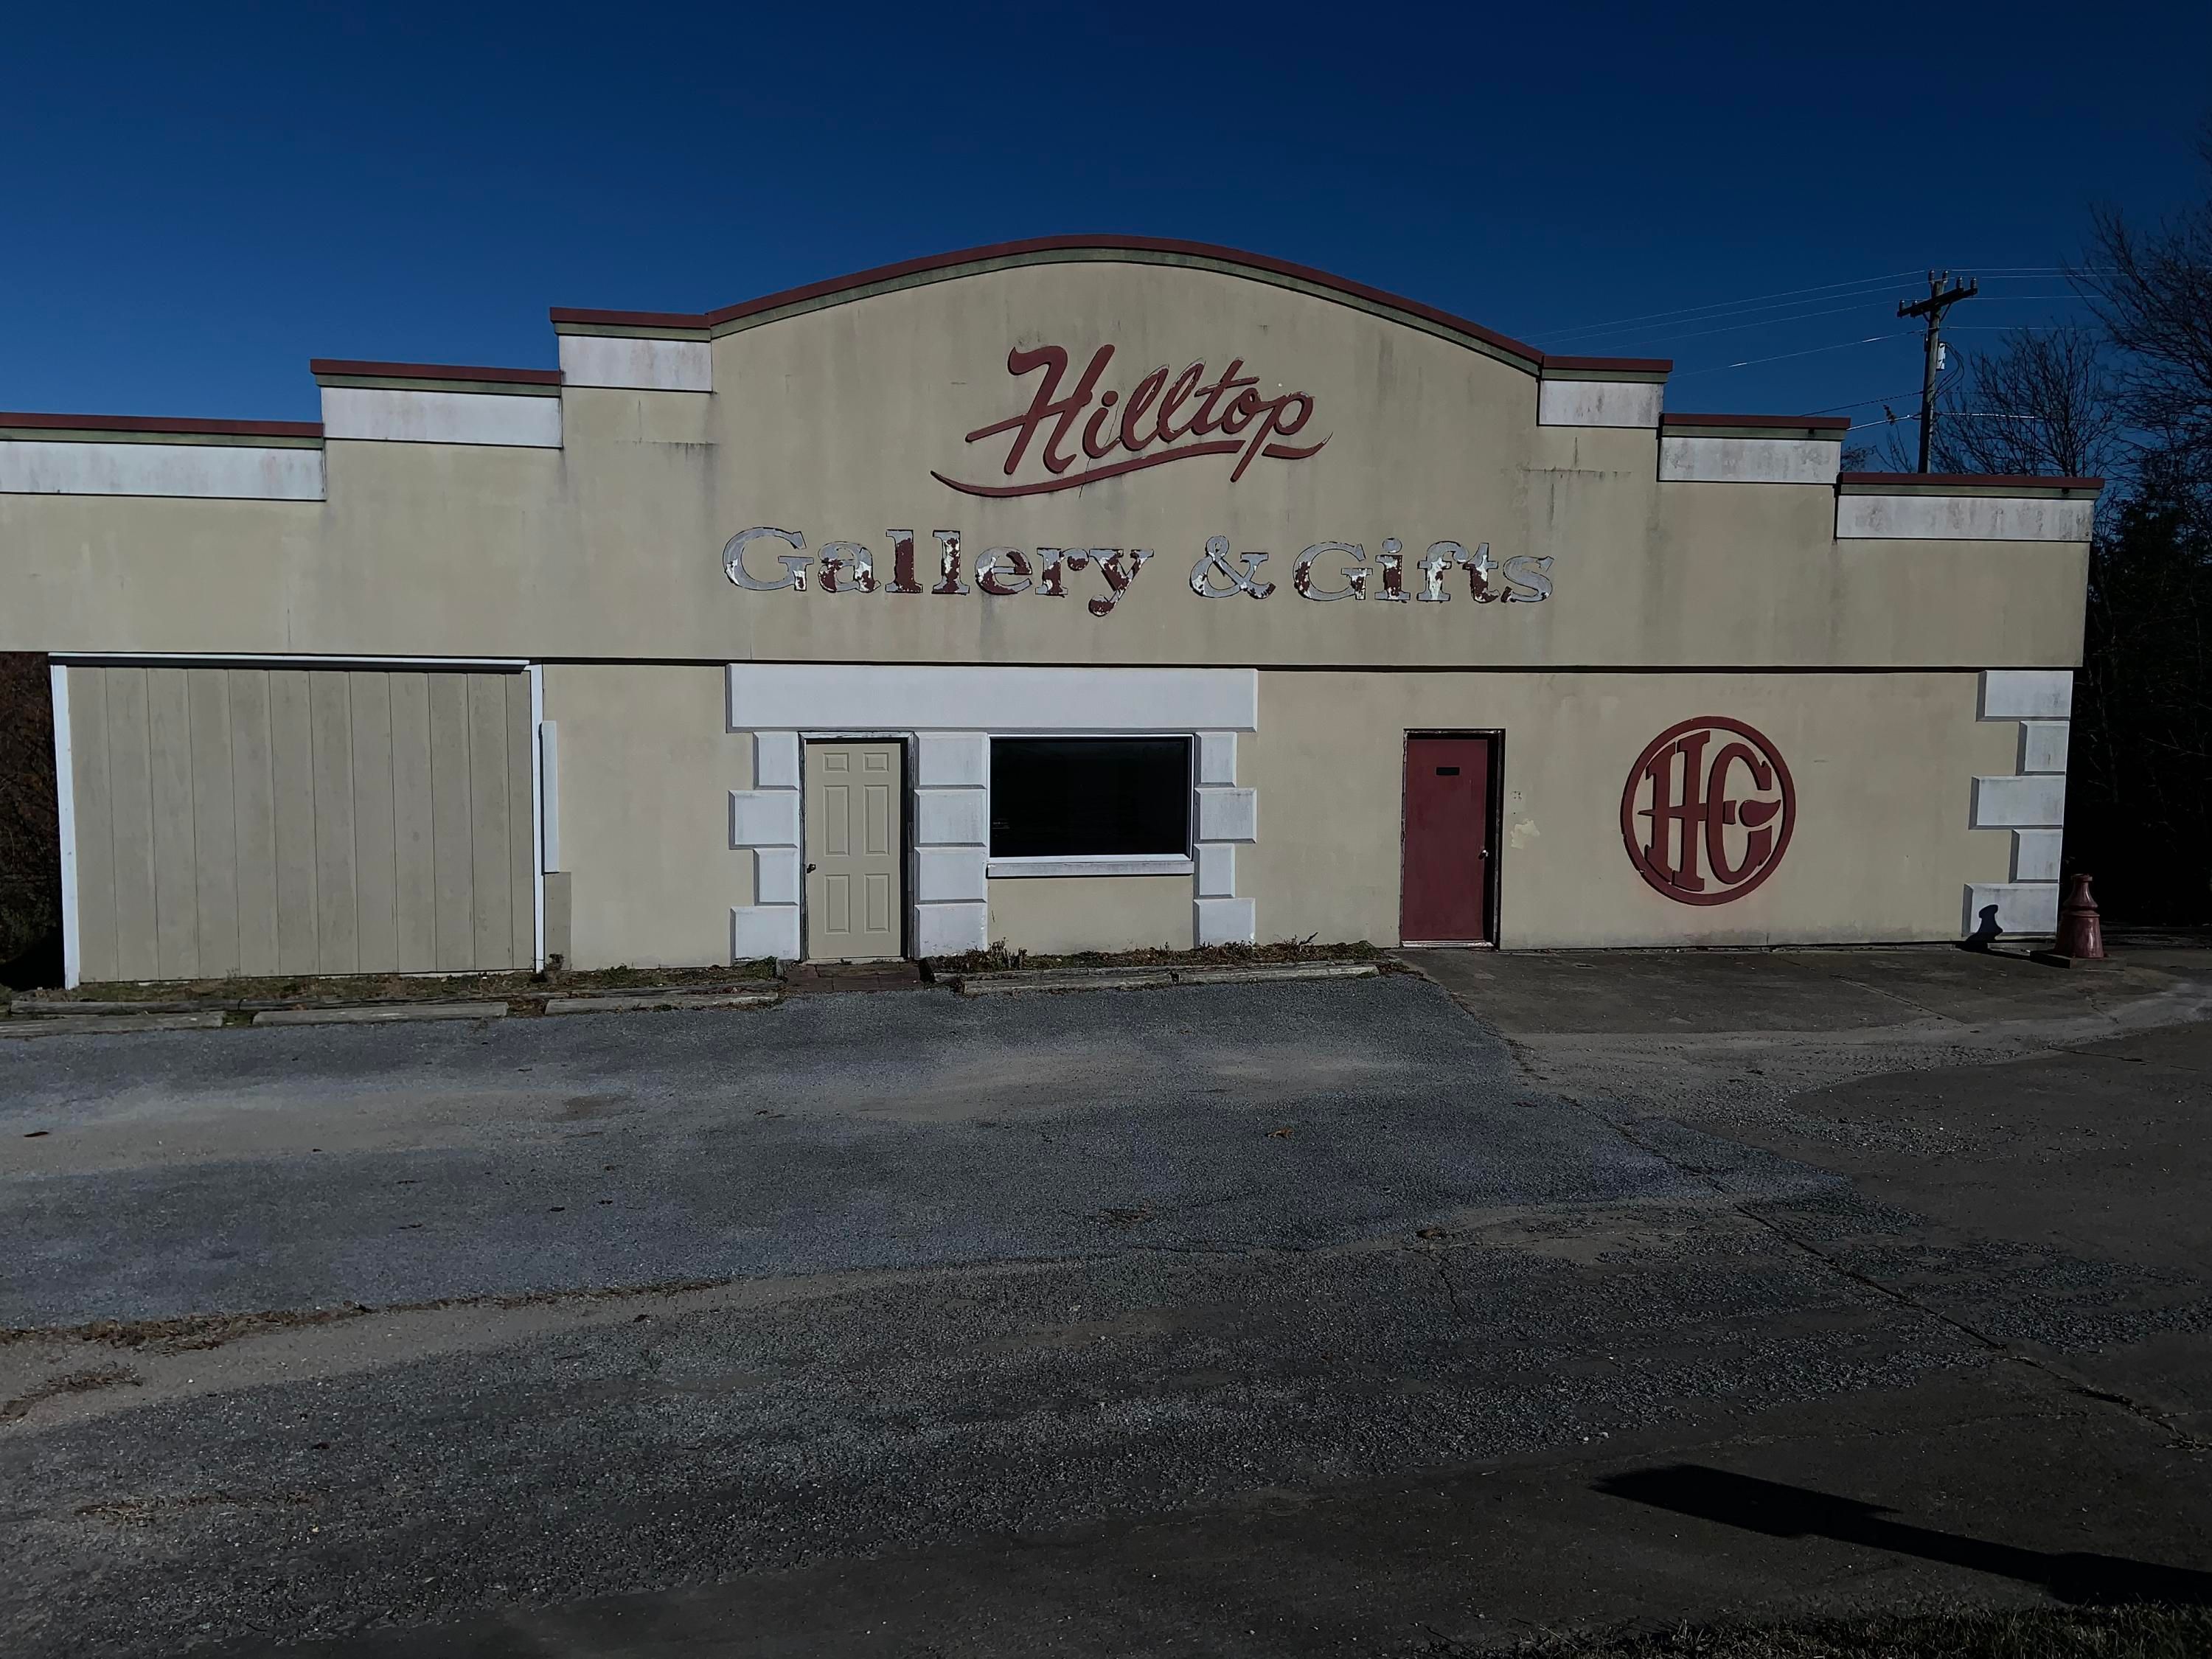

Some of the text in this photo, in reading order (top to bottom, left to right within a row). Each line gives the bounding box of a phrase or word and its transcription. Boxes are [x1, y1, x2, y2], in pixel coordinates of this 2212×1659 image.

[964, 344, 1315, 483] Hilltop
[722, 526, 1554, 617] Gallery & Gifts
